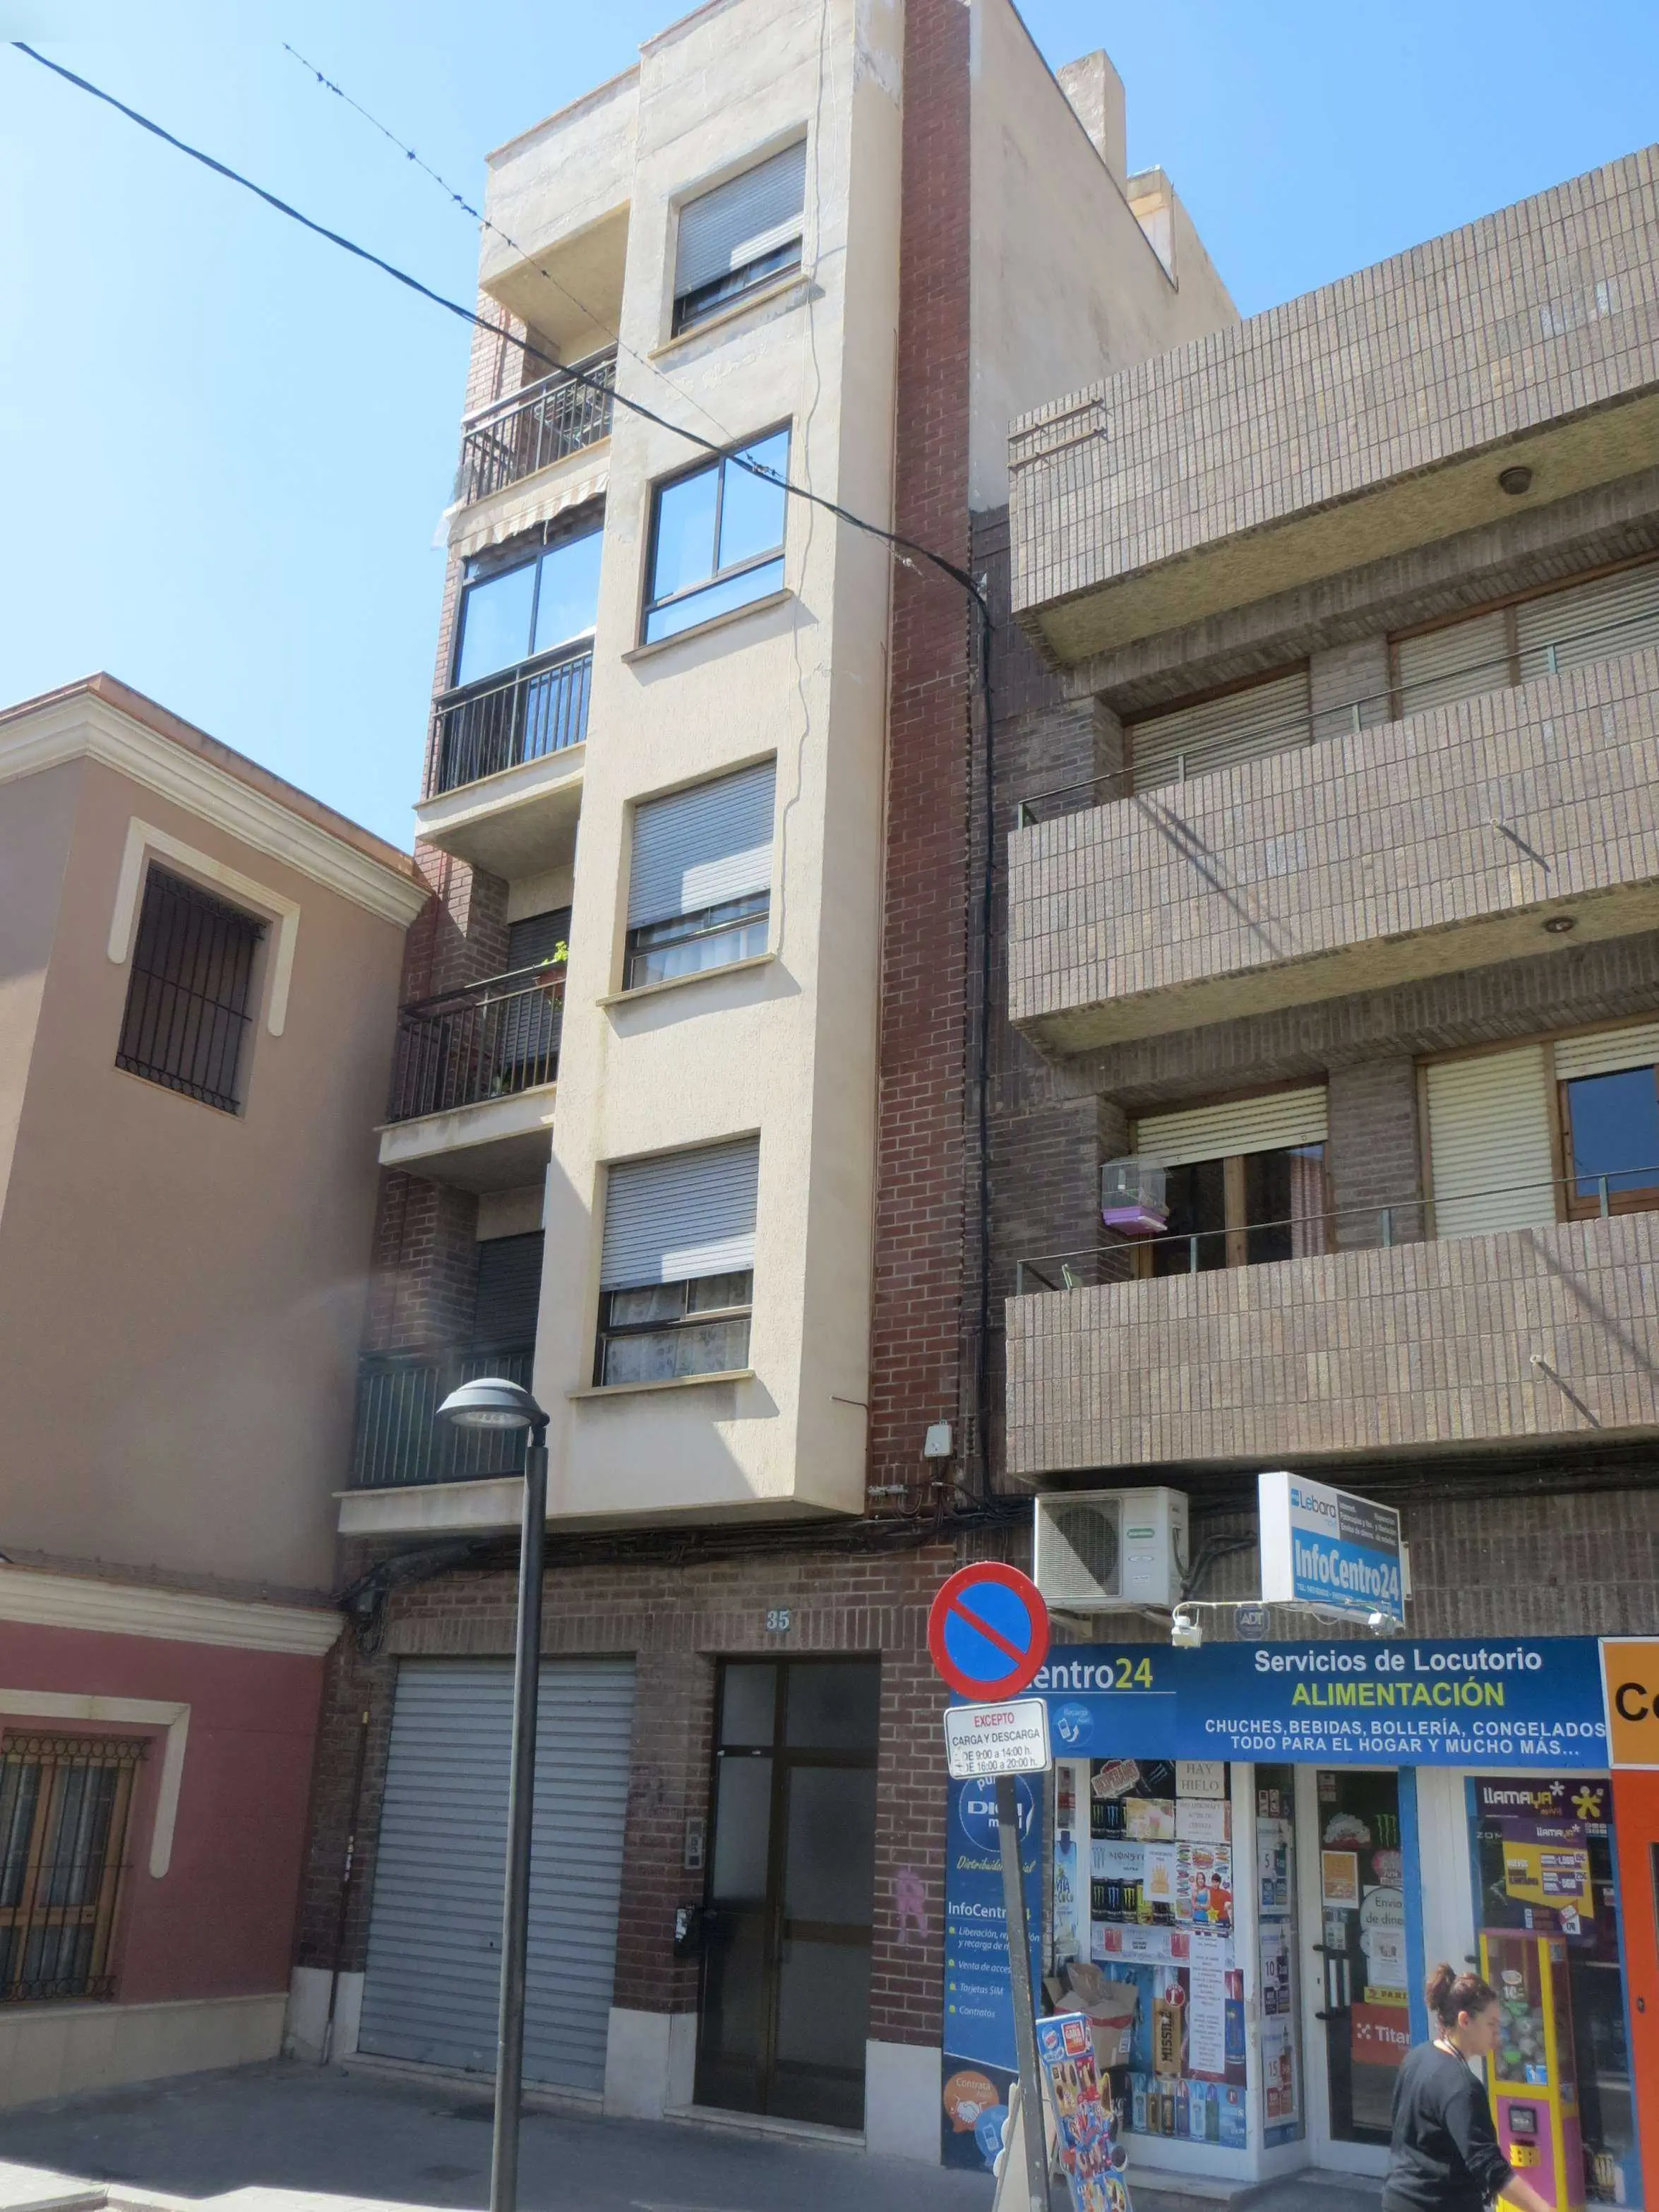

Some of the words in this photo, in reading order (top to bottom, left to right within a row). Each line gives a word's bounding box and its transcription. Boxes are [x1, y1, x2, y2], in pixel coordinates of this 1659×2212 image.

[1300, 1490, 1336, 1518] Lebara
[1295, 1539, 1399, 1601] InfoCentro24
[1240, 1612, 1264, 1625] ADT
[1254, 1649, 1367, 1672] Servicios
[1374, 1649, 1406, 1671] de
[1413, 1647, 1543, 1671] Locutorio
[1028, 1657, 1153, 1690] entro24
[1291, 1676, 1505, 1706] ALIMENTACIÓN
[1615, 1682, 1659, 1721] C
[974, 1711, 1015, 1728] EXCEPTO
[1371, 1718, 1466, 1738] BOLLERÍA,
[1473, 1721, 1606, 1738] CONGELADOS
[952, 1733, 984, 1747] CARGA
[983, 1733, 990, 1744] Y
[991, 1728, 1041, 1743] DESCARGA
[1230, 1735, 1276, 1750] TODO
[1281, 1737, 1327, 1751] PARA
[1332, 1738, 1353, 1752] EL
[1358, 1738, 1423, 1752] HOGAR
[1428, 1739, 1440, 1753] Y
[1445, 1739, 1514, 1754] MUCHO
[1520, 1737, 1581, 1755] MÁS...
[975, 1750, 993, 1759] 9:00
[1002, 1746, 1023, 1757] 14:00
[977, 1760, 998, 1771] 16:00
[1007, 1757, 1029, 1769] 20:00
[1186, 1762, 1215, 1775] HAY
[1181, 1779, 1219, 1792] HIELO
[948, 1901, 1031, 1920] InfoCentr
[1366, 1912, 1379, 1924] de
[1381, 1913, 1404, 1926] dine
[959, 1960, 979, 1971] Venta
[981, 1962, 990, 1972] de
[960, 1983, 989, 1995] Tarjetas
[990, 1984, 1005, 1996] SIM
[959, 2004, 995, 2018] Contratos
[956, 2077, 991, 2091] Contrata
